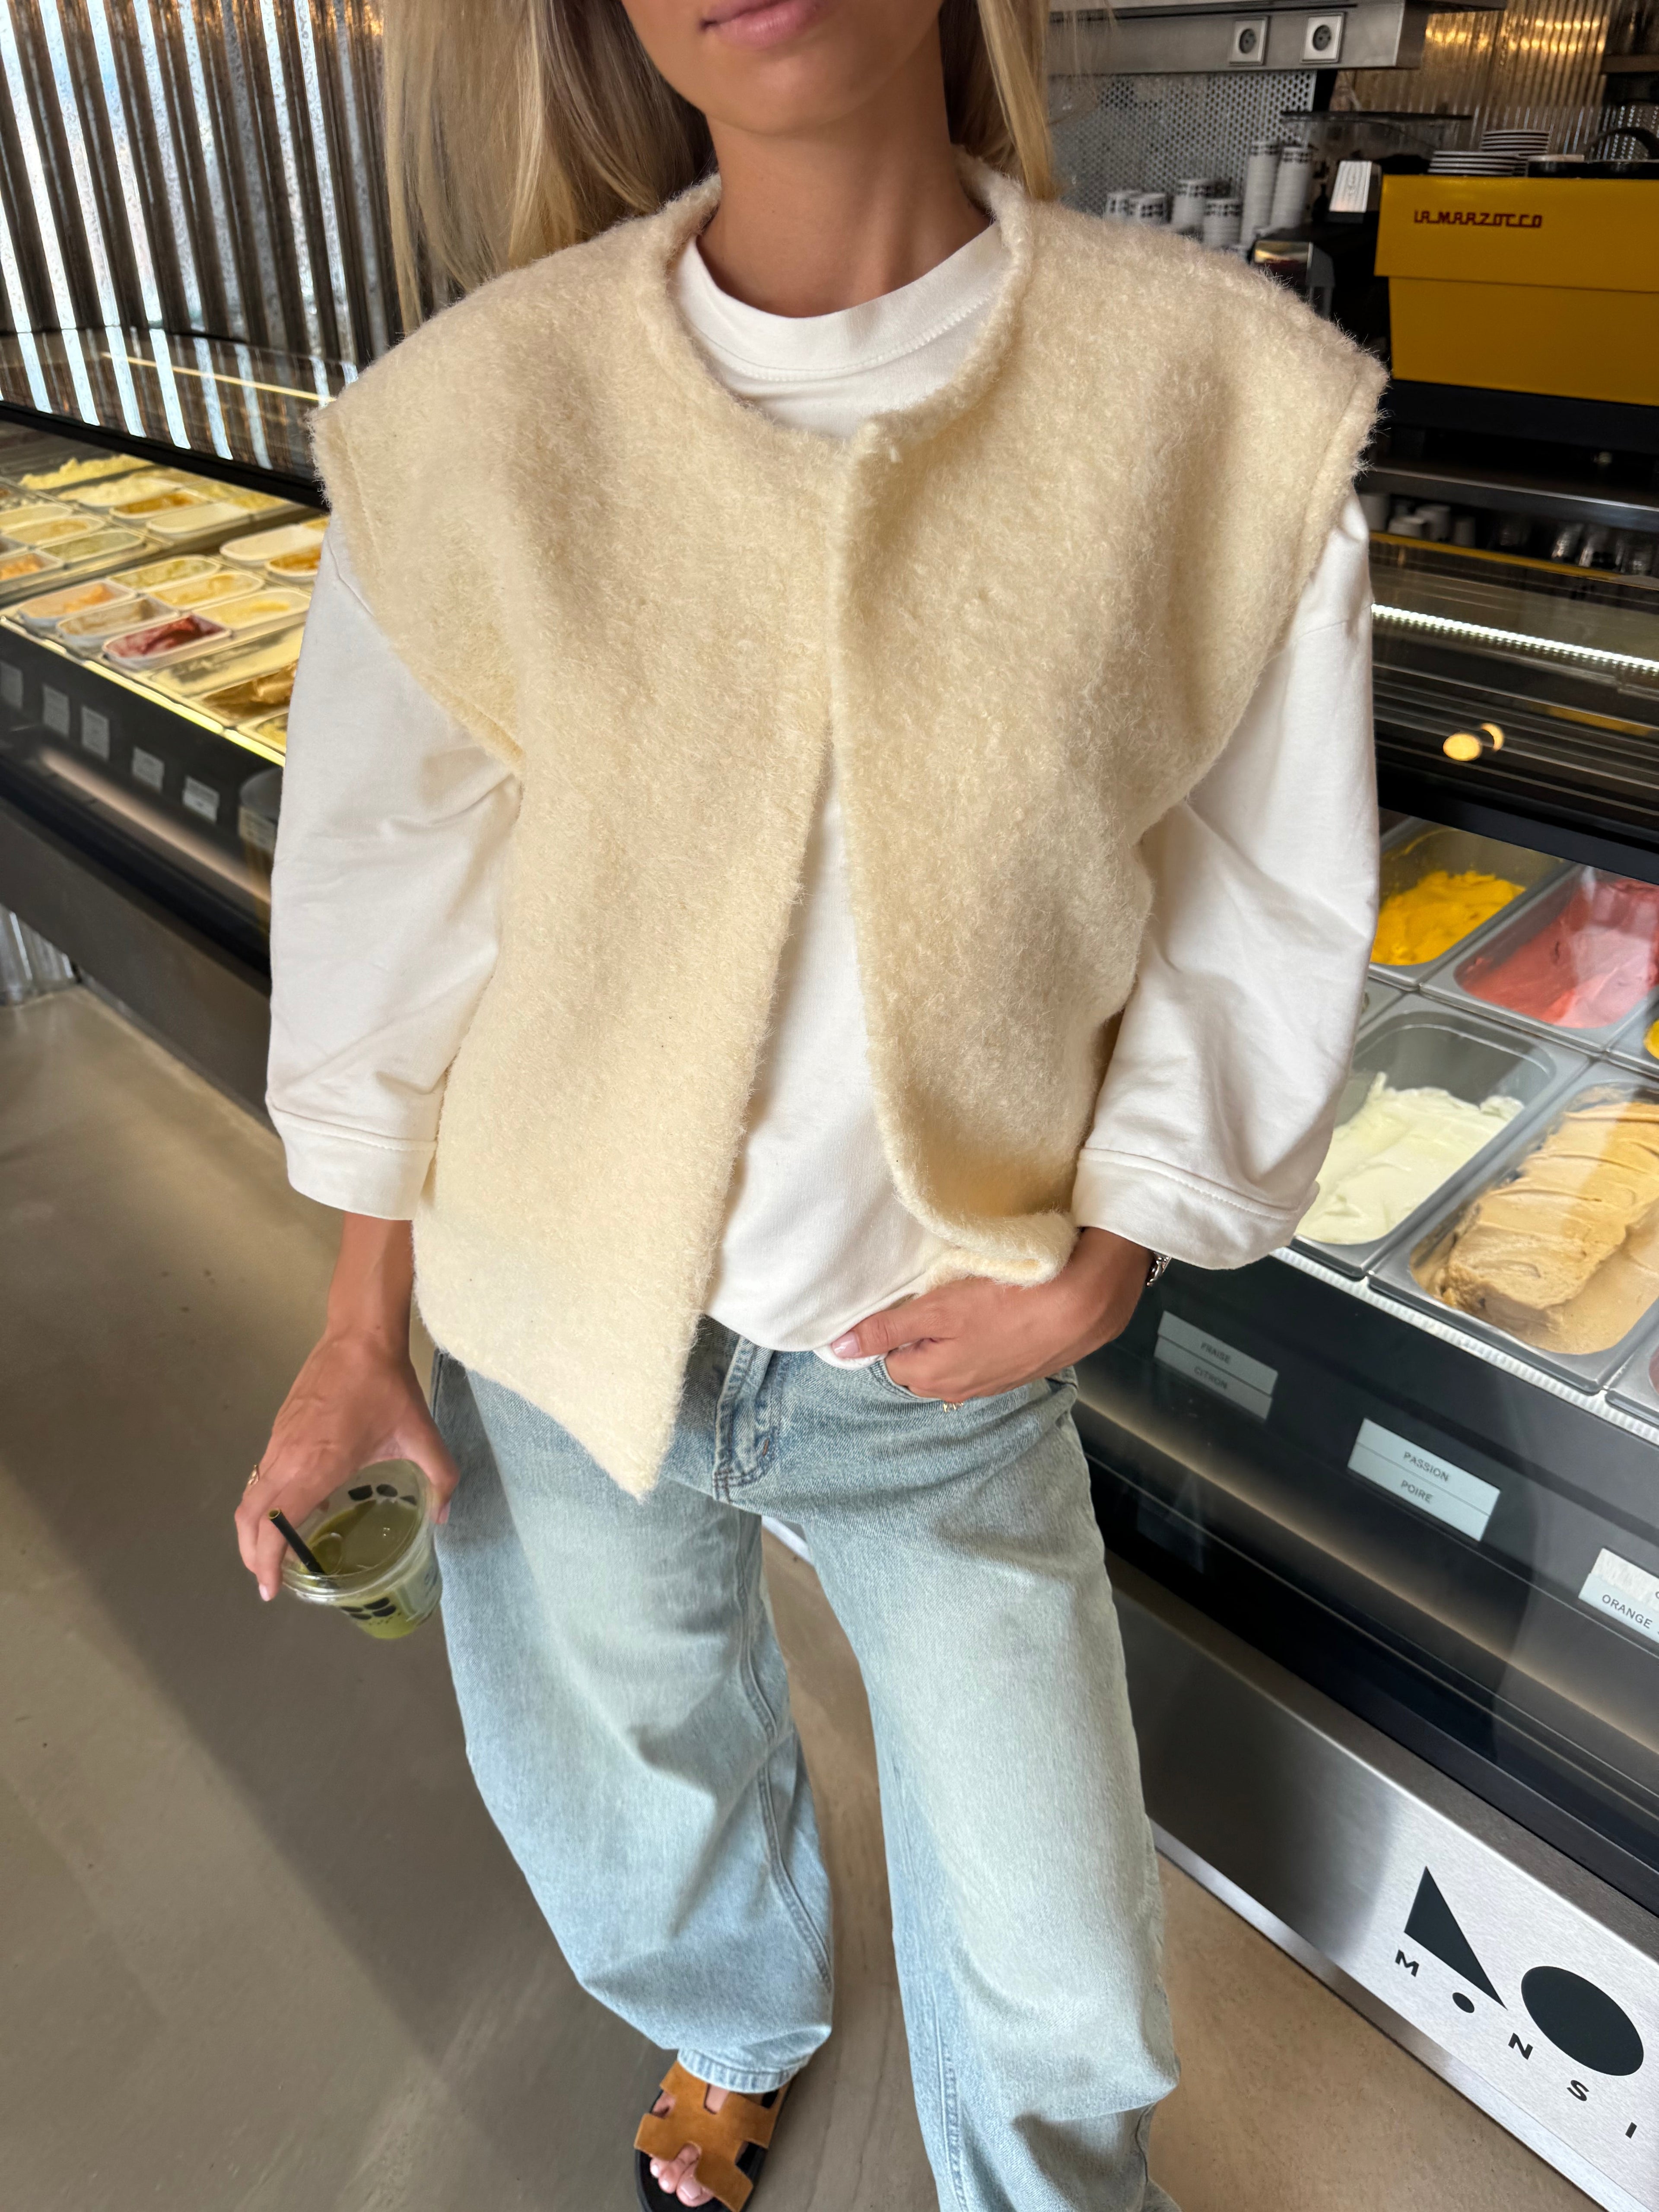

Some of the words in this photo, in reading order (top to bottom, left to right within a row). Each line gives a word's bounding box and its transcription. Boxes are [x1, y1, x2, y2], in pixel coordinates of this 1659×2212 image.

[1201, 1342, 1231, 1365] FRAISE
[1194, 1366, 1228, 1390] CITRON
[1403, 1451, 1449, 1482] PASSION
[1401, 1479, 1433, 1503] POIRE
[1602, 1594, 1653, 1629] ORANGE
